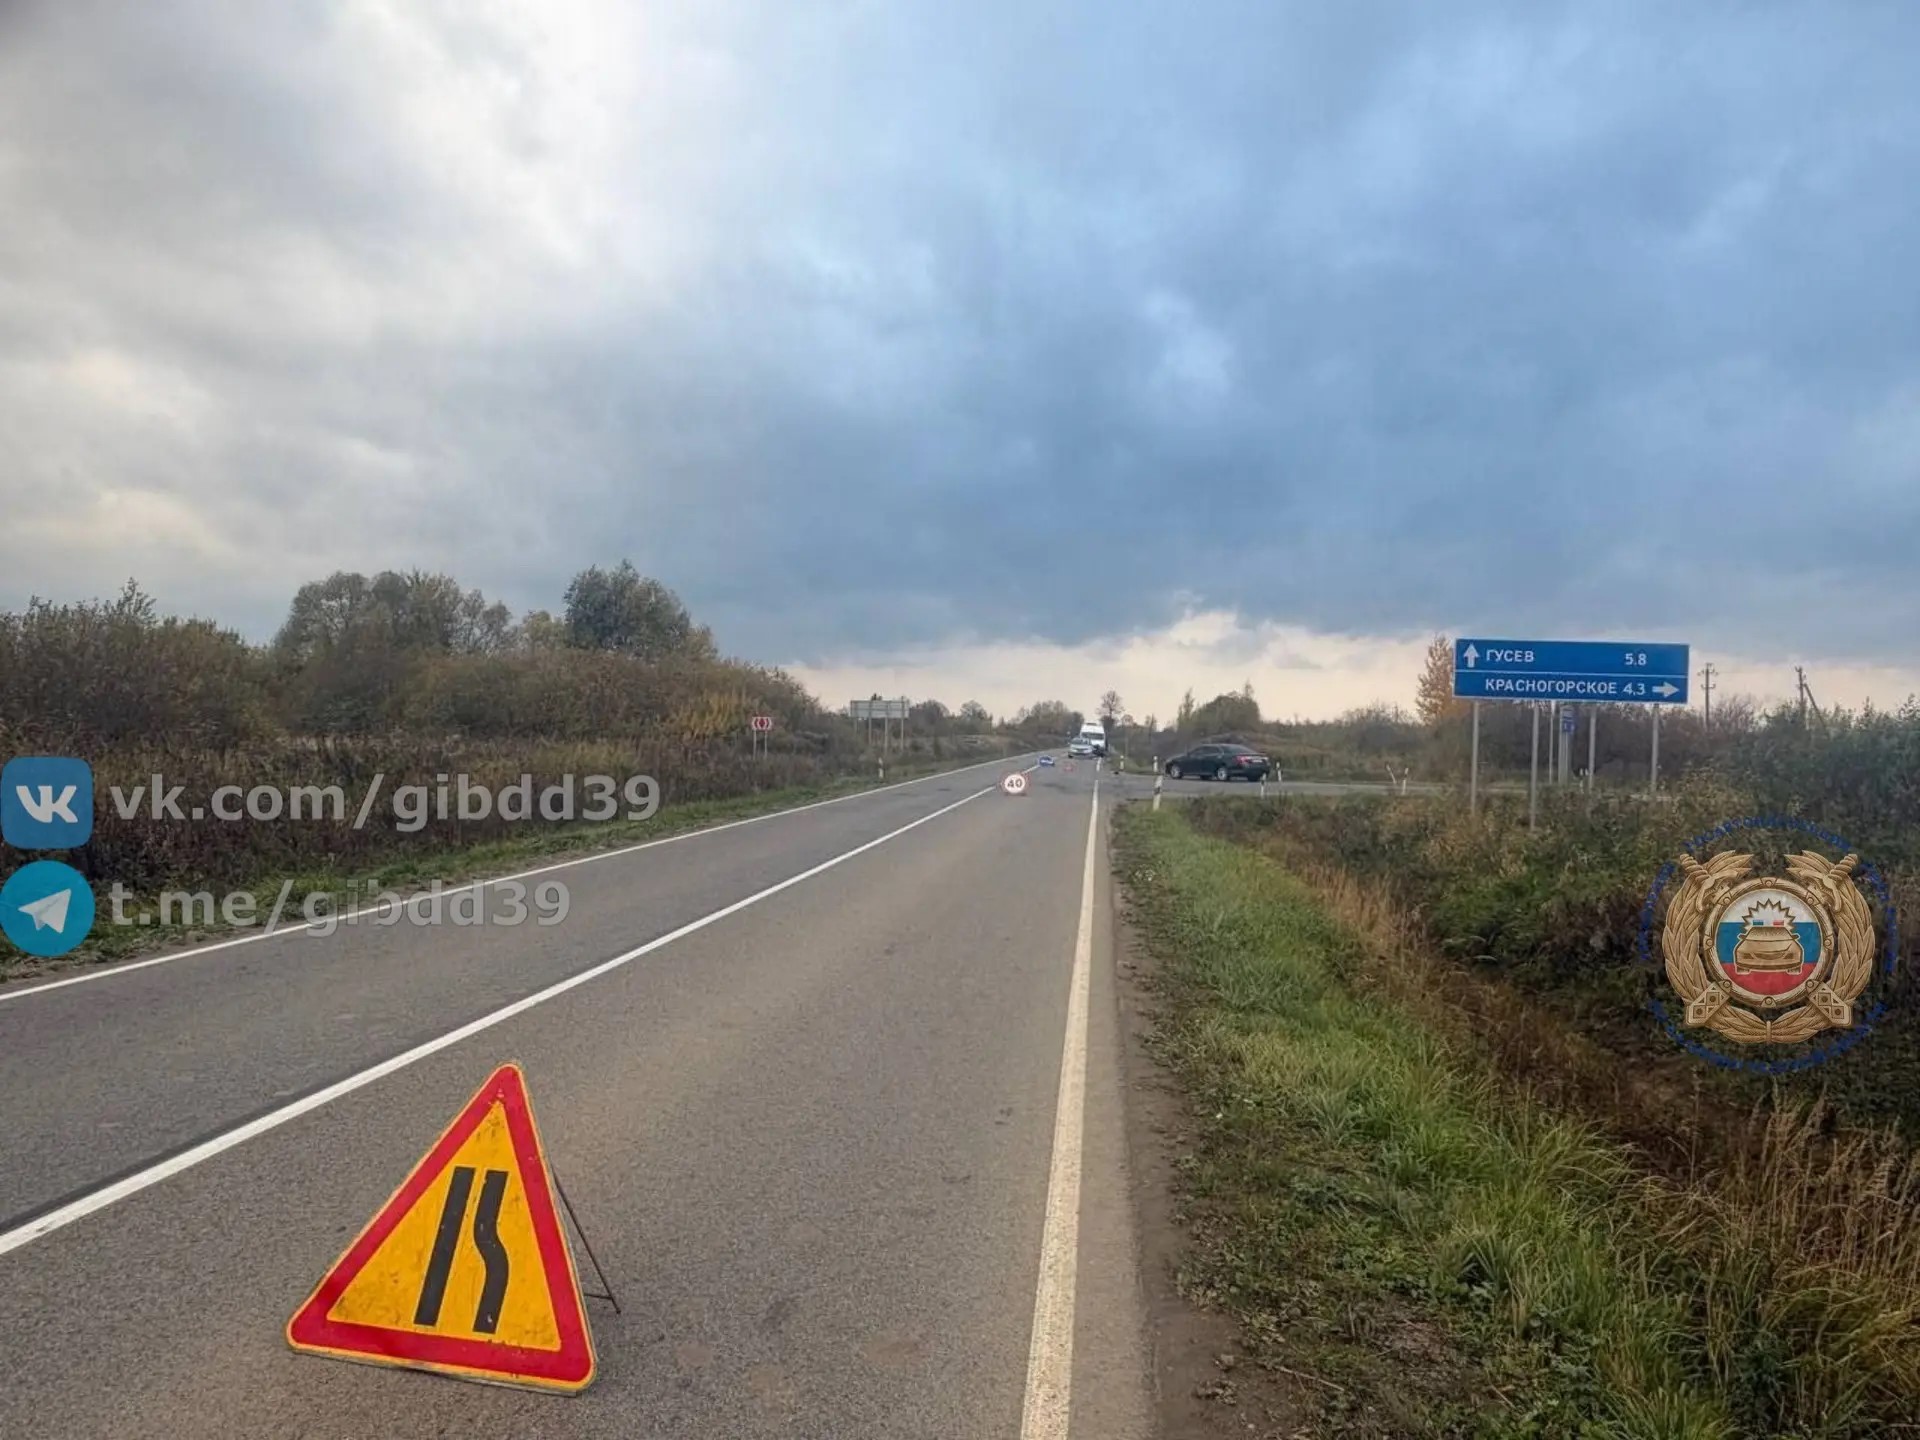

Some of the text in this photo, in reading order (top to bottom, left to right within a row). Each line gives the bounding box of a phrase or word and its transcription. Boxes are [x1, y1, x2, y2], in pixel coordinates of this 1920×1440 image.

[1486, 649, 1535, 663] ГУСЕВ
[1485, 678, 1617, 695] КРАСНОГОРСКОЕ
[1007, 778, 1023, 789] 40
